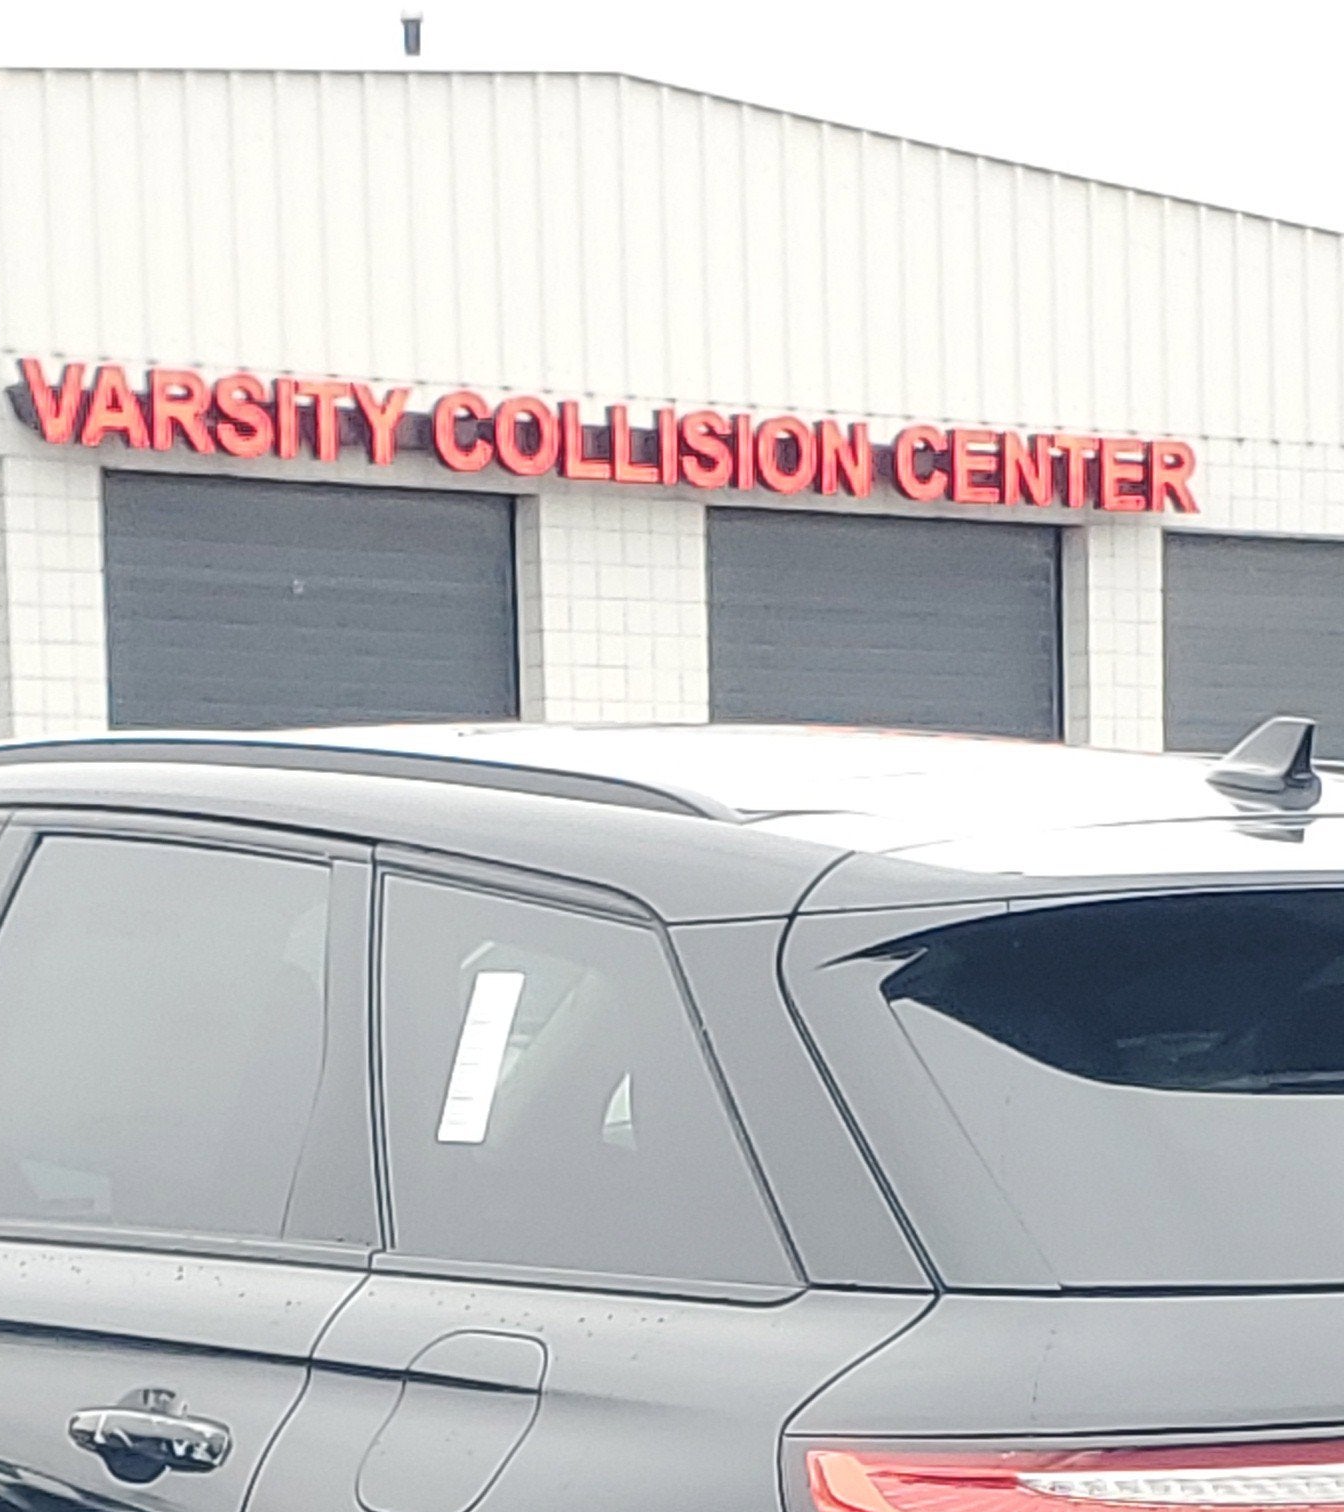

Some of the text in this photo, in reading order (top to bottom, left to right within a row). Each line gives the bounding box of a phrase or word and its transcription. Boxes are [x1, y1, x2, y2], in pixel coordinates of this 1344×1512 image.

[22, 358, 1198, 514] VARSITY COLLISION CENTER
